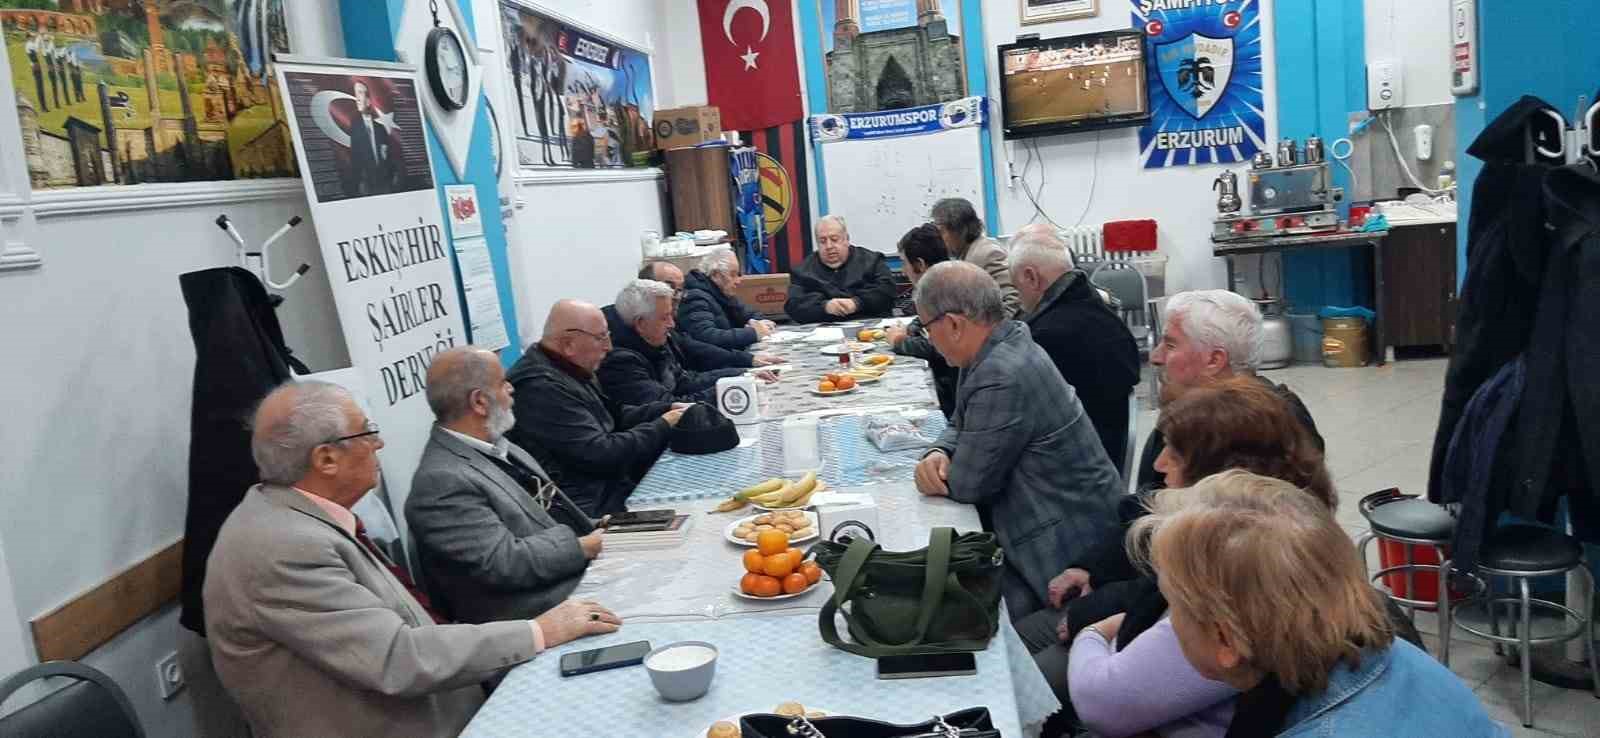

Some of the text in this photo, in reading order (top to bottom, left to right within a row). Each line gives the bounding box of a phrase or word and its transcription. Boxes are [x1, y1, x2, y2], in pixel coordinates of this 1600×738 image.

[850, 109, 937, 129] ERZURUMSPOR
[1157, 126, 1244, 149] ERZURUM
[337, 216, 446, 282] ESKİŞEHİR
[366, 283, 448, 352] ŞAİRLER
